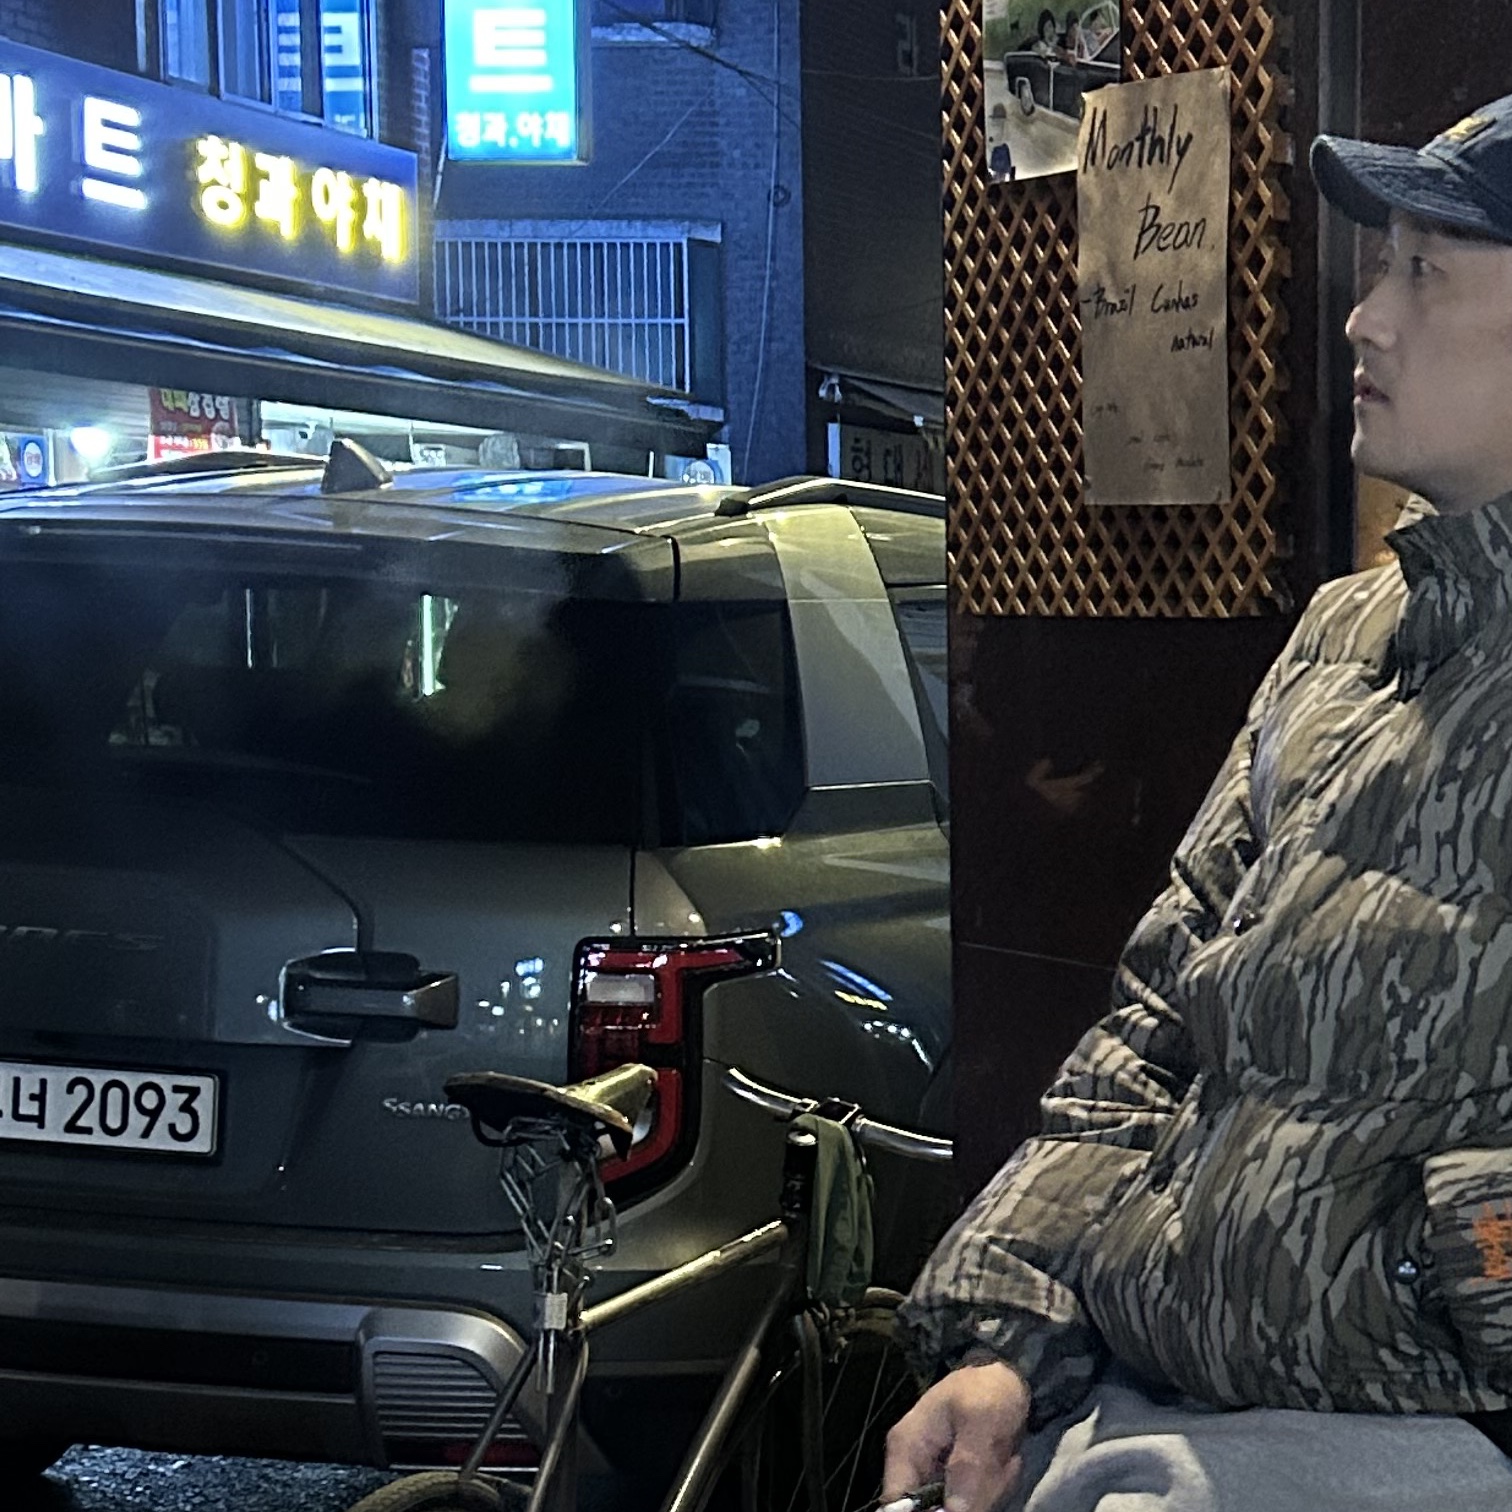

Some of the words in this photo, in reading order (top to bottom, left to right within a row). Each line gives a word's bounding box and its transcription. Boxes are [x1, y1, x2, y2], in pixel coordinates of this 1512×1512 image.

[1083, 103, 1194, 195] Monthly
[195, 133, 410, 263] 청과야채
[63, 1075, 201, 1143] 2093
